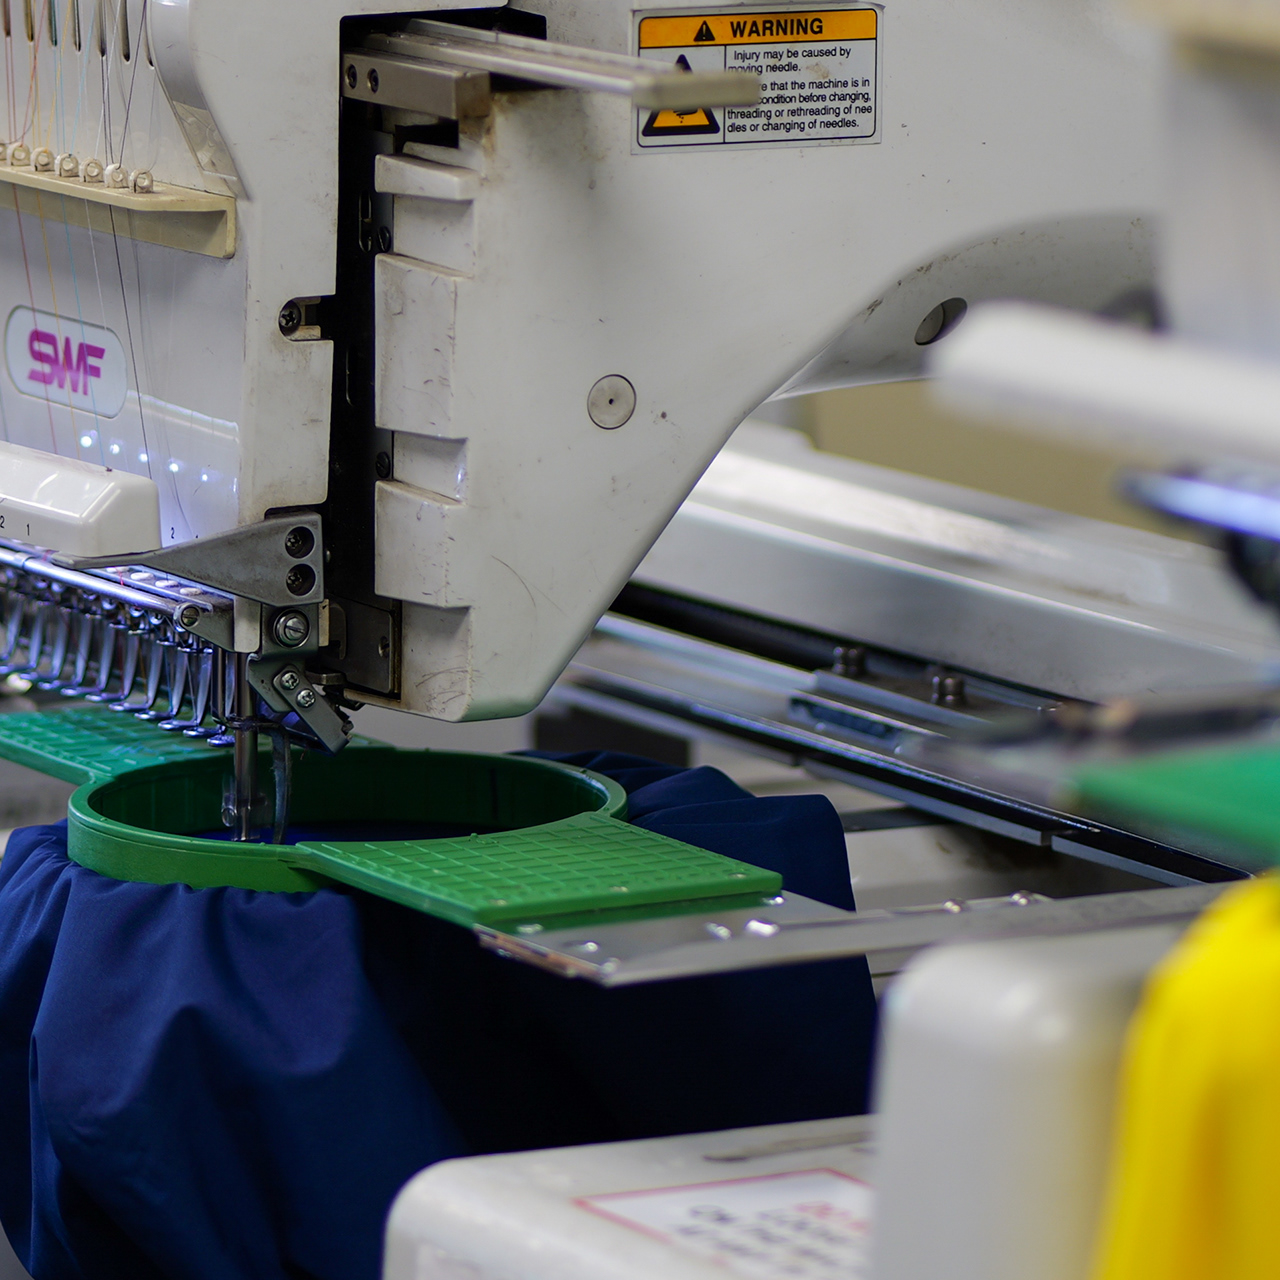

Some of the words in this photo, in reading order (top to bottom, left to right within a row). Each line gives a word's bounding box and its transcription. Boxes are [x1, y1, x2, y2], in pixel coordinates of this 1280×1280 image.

[730, 18, 824, 38] WARNING
[734, 50, 761, 63] Injury
[763, 50, 785, 62] may
[786, 48, 799, 59] be
[801, 46, 838, 58] caused
[839, 46, 852, 59] by
[765, 62, 801, 73] needle.
[770, 80, 789, 91] that
[790, 80, 806, 90] the
[808, 78, 849, 89] machine
[851, 77, 859, 87] is
[861, 77, 870, 87] in
[798, 92, 827, 103] before
[727, 107, 772, 120] threading
[774, 108, 785, 117] or
[787, 105, 841, 118] rethreading
[843, 104, 852, 115] of
[854, 105, 872, 114] nee
[727, 122, 747, 133] dles
[749, 123, 760, 132] or
[761, 120, 806, 133] changing
[808, 118, 817, 130] of
[819, 118, 860, 130] needles.
[28, 328, 105, 396] SWF
[0, 515, 5, 529] 2
[170, 526, 175, 539] 2
